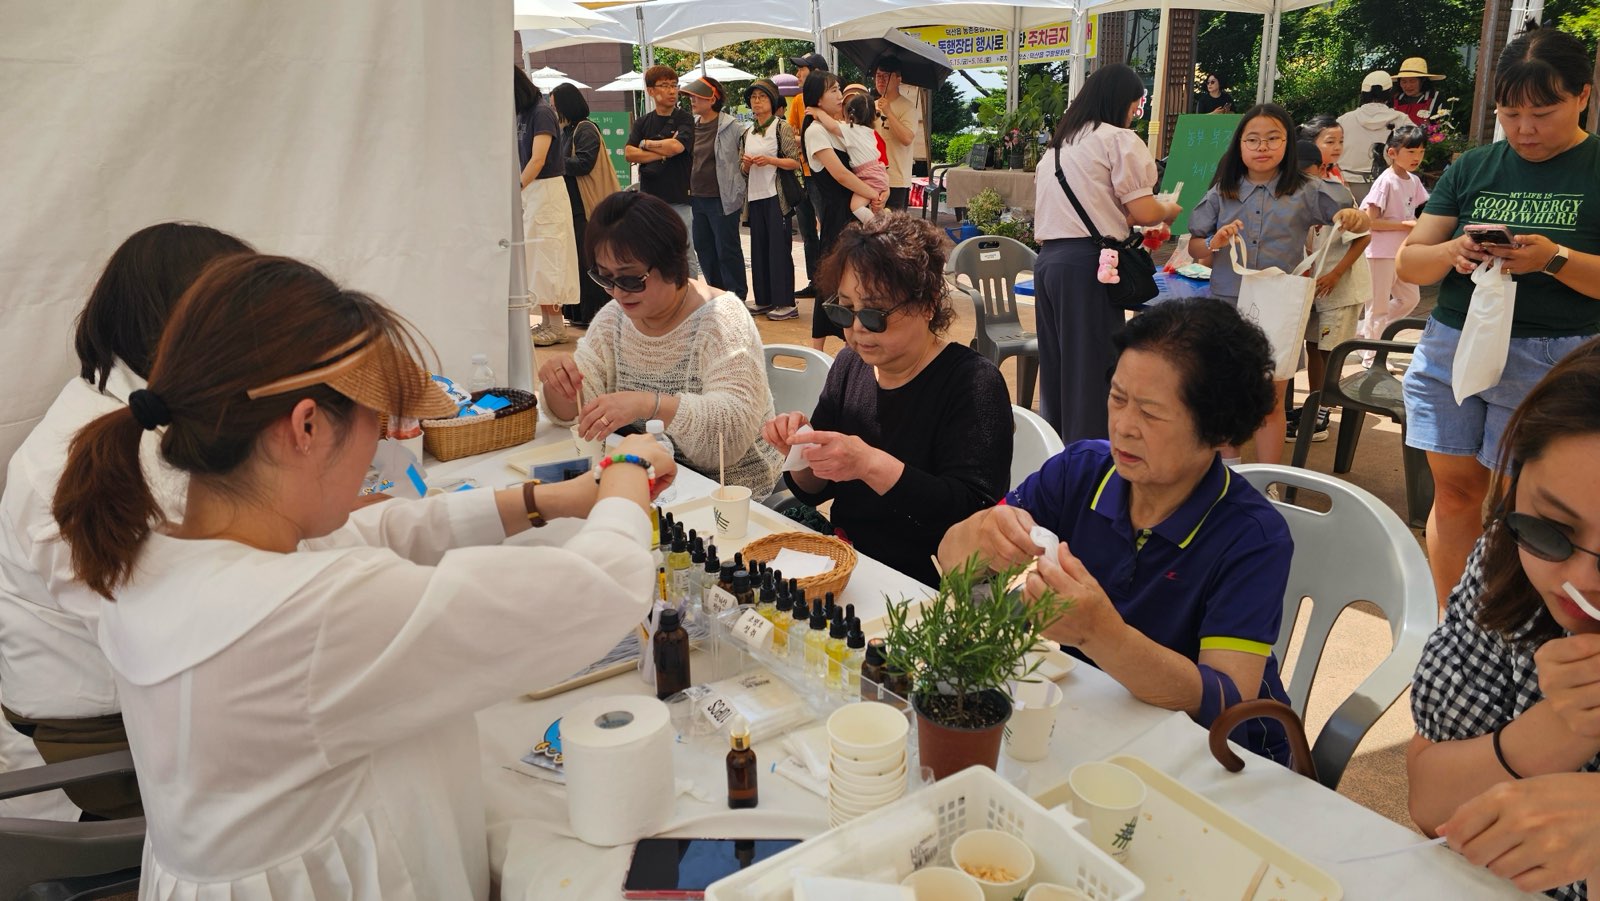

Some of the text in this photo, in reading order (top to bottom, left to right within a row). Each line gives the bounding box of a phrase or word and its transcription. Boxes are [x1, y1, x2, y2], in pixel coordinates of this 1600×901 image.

[938, 36, 974, 55] 동행장터
[976, 35, 1004, 52] 행사로
[1028, 26, 1069, 47] 주차금지
[1474, 196, 1583, 213] GOOD ENERGY
[1543, 192, 1553, 200] IS
[1471, 208, 1578, 226] EVERYWHERE
[707, 699, 733, 724] 10PCS
